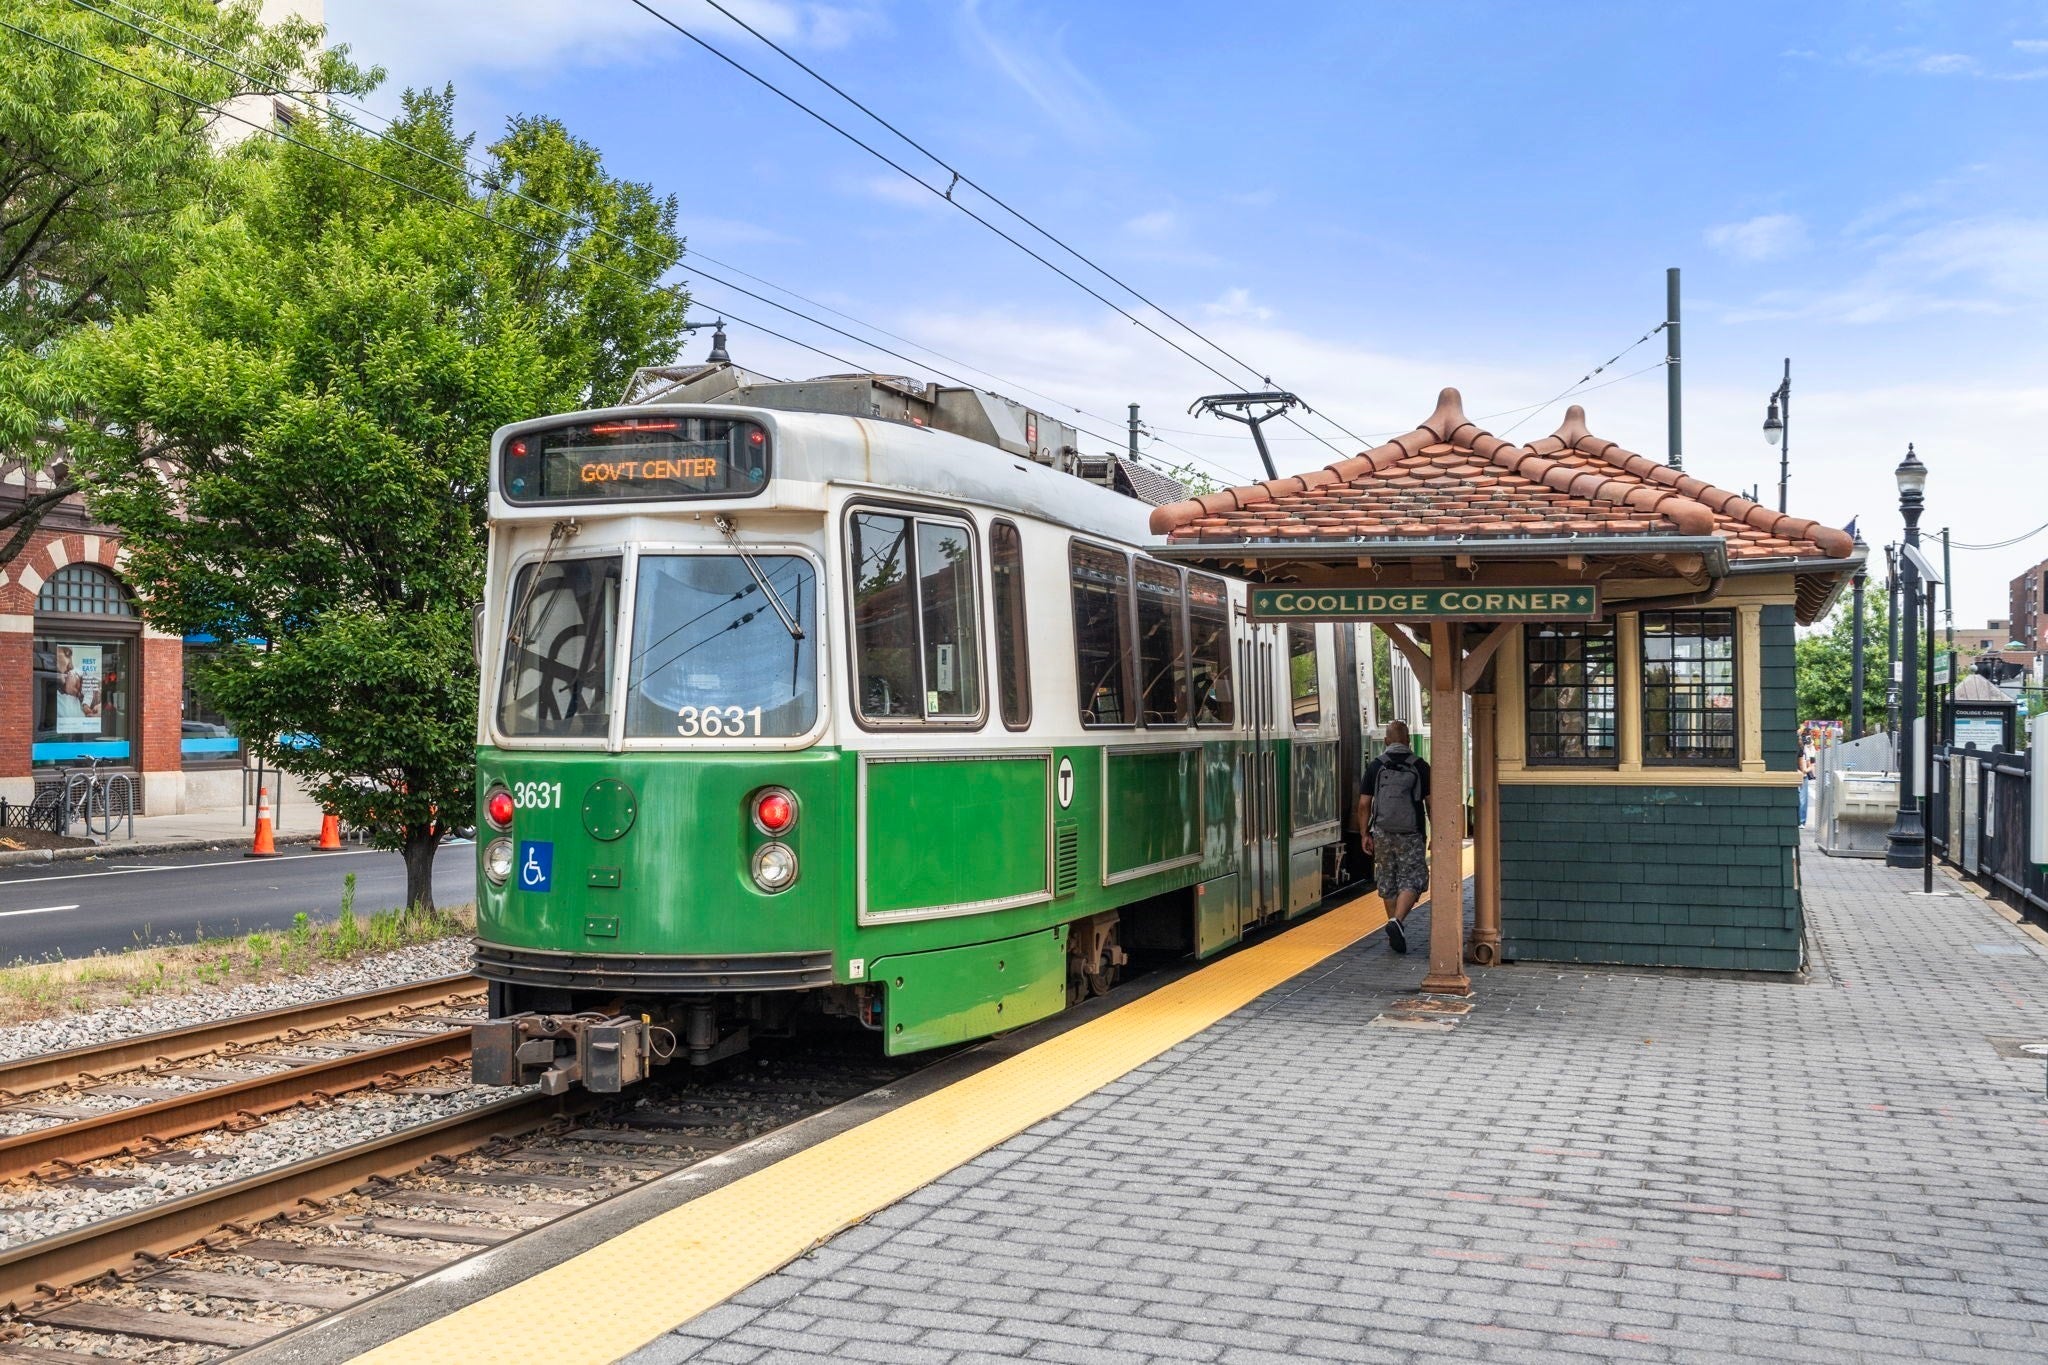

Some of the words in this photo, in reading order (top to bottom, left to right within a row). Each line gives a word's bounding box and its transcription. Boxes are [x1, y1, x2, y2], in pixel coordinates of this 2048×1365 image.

[581, 462, 638, 481] GOV'T
[642, 458, 716, 479] CENTER
[1275, 594, 1428, 611] COOLIDGE
[1440, 592, 1570, 610] CORNER
[677, 705, 762, 736] 3631
[513, 781, 562, 808] 3631
[1060, 770, 1072, 801] T
